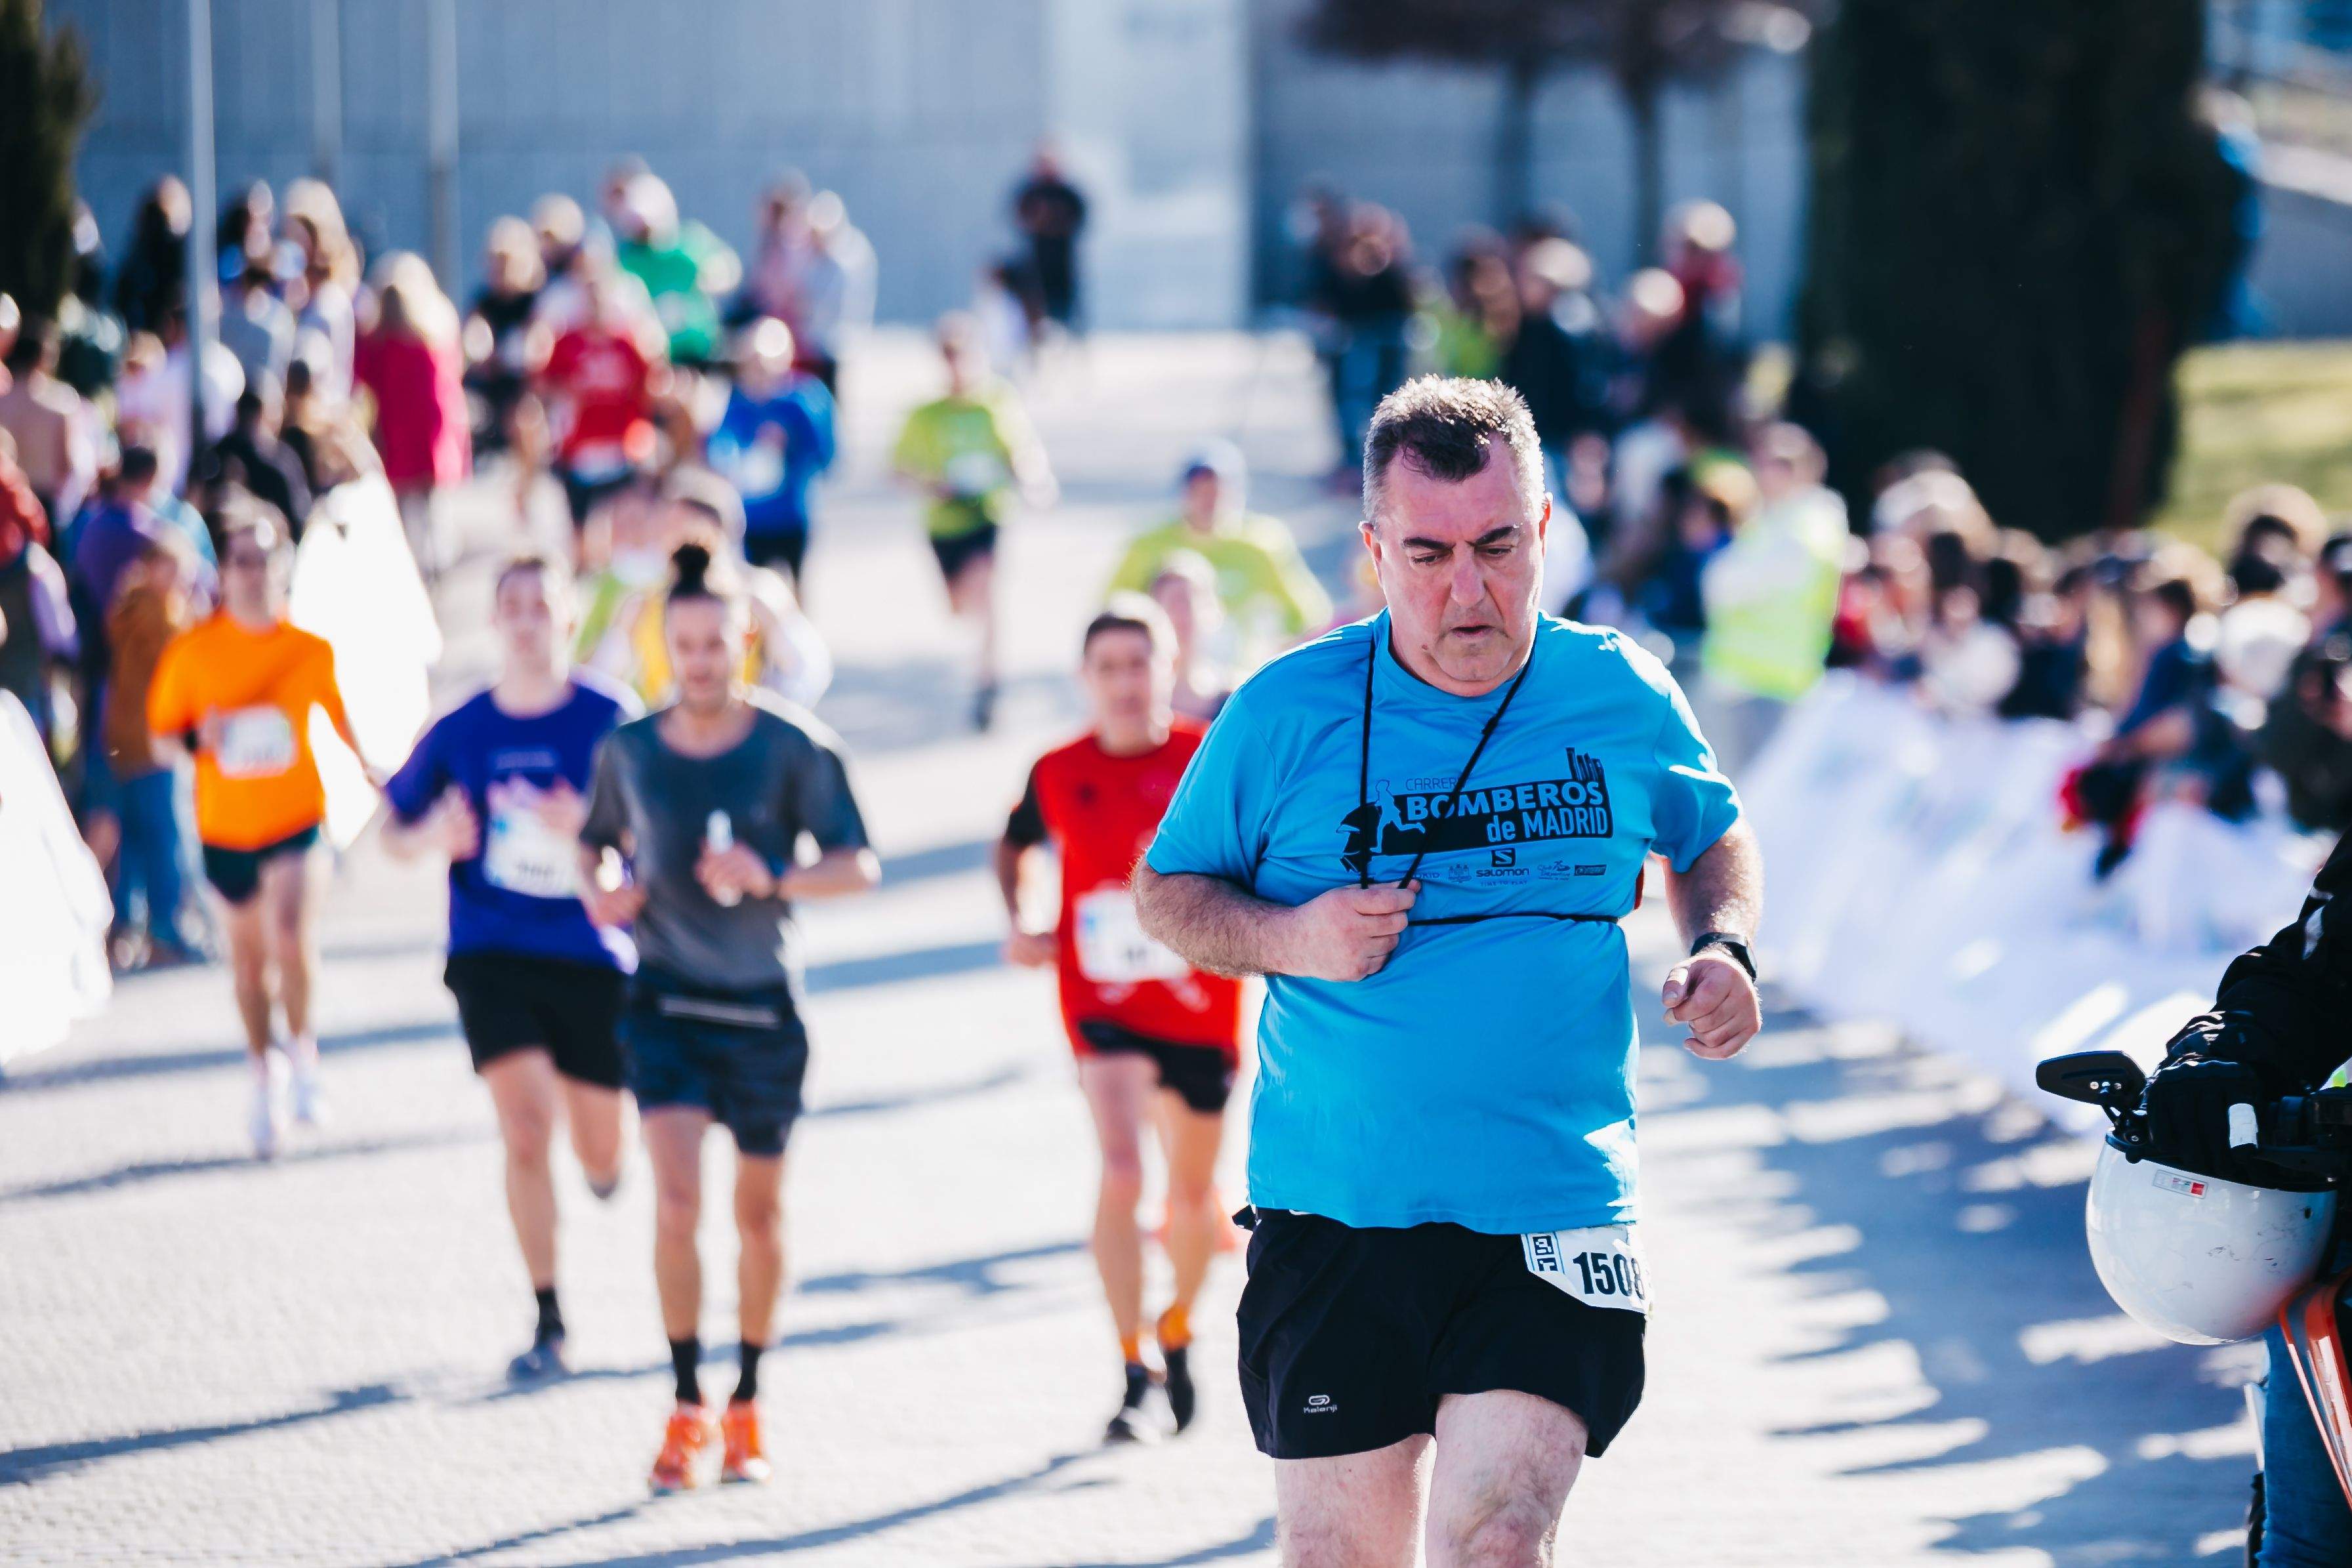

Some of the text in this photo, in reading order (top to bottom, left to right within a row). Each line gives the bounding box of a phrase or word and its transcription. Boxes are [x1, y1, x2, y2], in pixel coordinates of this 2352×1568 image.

[1405, 777, 1466, 791] CARRER
[1406, 781, 1603, 821] BOMBEROS
[1487, 808, 1608, 842] de MADRID
